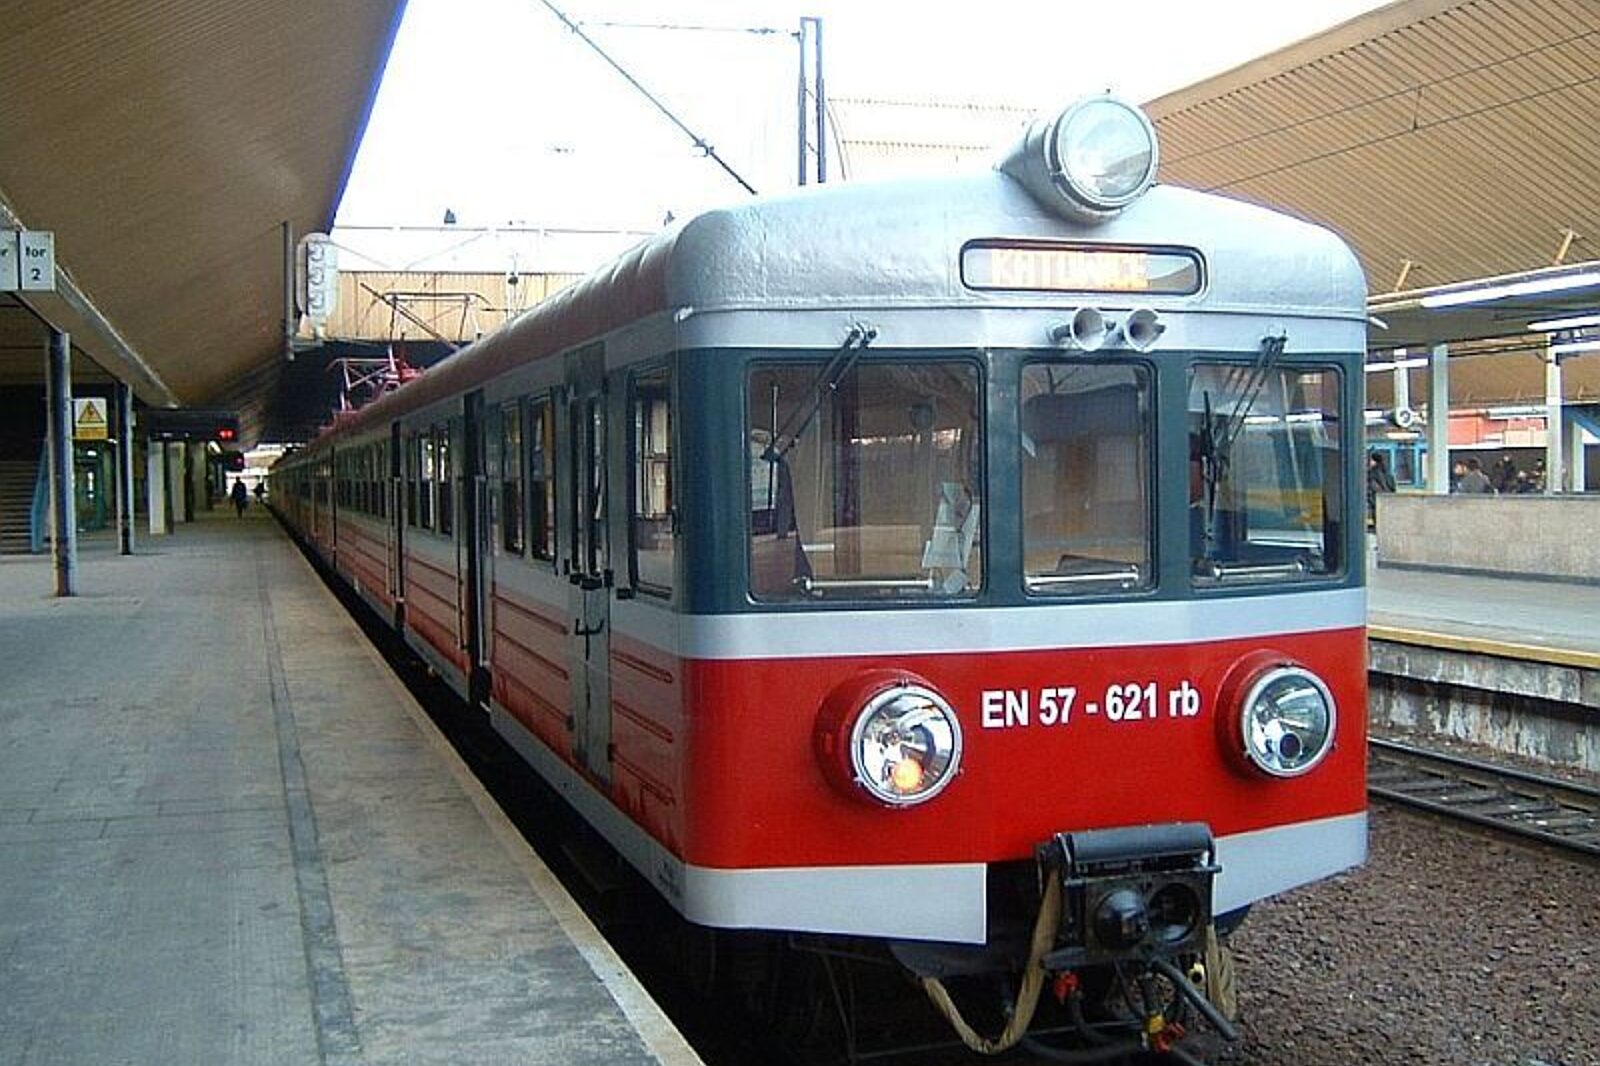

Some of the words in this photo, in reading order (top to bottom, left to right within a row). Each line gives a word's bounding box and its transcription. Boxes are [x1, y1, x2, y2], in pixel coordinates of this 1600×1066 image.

[31, 268, 41, 281] 2
[981, 689, 1029, 728] EN
[1039, 687, 1077, 725] 57
[1085, 702, 1099, 714] -
[1105, 682, 1158, 721] 621
[1169, 680, 1200, 718] rb
